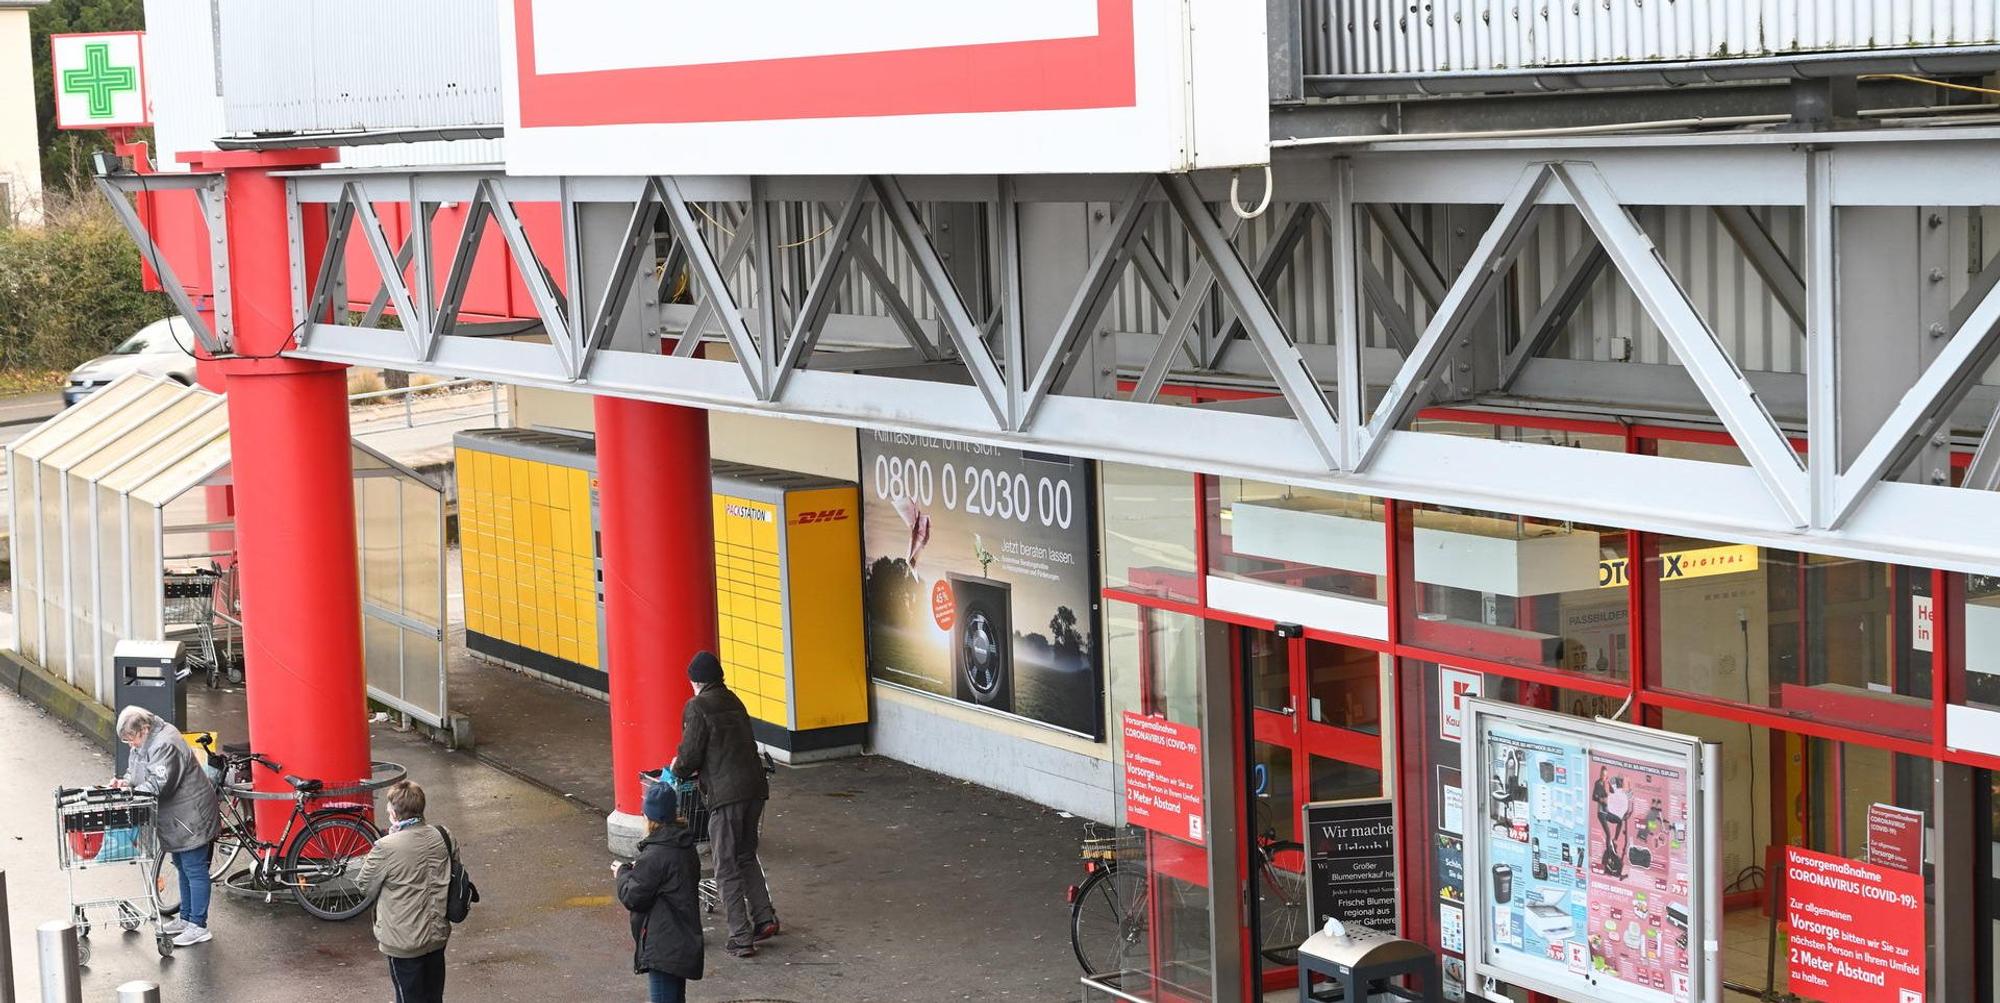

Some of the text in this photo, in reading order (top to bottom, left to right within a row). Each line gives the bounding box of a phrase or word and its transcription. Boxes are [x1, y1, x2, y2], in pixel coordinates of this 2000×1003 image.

[875, 454, 1072, 530] 0800 0 2030 00
[727, 503, 766, 521] PACKSTATION
[798, 509, 848, 524] DHL
[1001, 539, 1019, 554] Jetzt
[1020, 542, 1048, 558] beraten
[1048, 547, 1075, 565] lassen.
[1682, 554, 1744, 569] DIGITAL
[1569, 609, 1628, 625] PASSBILDER
[1918, 605, 1934, 621] He
[1125, 715, 1177, 735] Vorsorgemaßnahme
[1445, 715, 1460, 727] Kau
[1125, 727, 1165, 746] CORONAVIRUS
[1127, 762, 1155, 781] Vorsorge
[1127, 789, 1181, 813] 2 Meter Abstand
[1322, 823, 1394, 839] Wir mache
[1871, 847, 1895, 860] Vorsorge
[1353, 862, 1377, 870] Großer
[1789, 850, 1882, 882] Vorsorgemaßnahme
[1332, 871, 1383, 881] Blumenverkauf
[1789, 868, 1918, 909] CORONAVIRUS (COVID-19):
[1338, 897, 1395, 907] Frische Blumen
[1790, 897, 1852, 922] Zur allgemeinen
[1344, 908, 1375, 918] regional
[1363, 917, 1396, 926] Gärtnere
[1790, 913, 1909, 956] Vorsorge bitten wir Sie zur
[1791, 935, 1920, 975] nächsten Person in Ihrem Umfeld
[1791, 949, 1885, 986] 2 Meter Abstand
[1791, 971, 1829, 987] zu halten.
